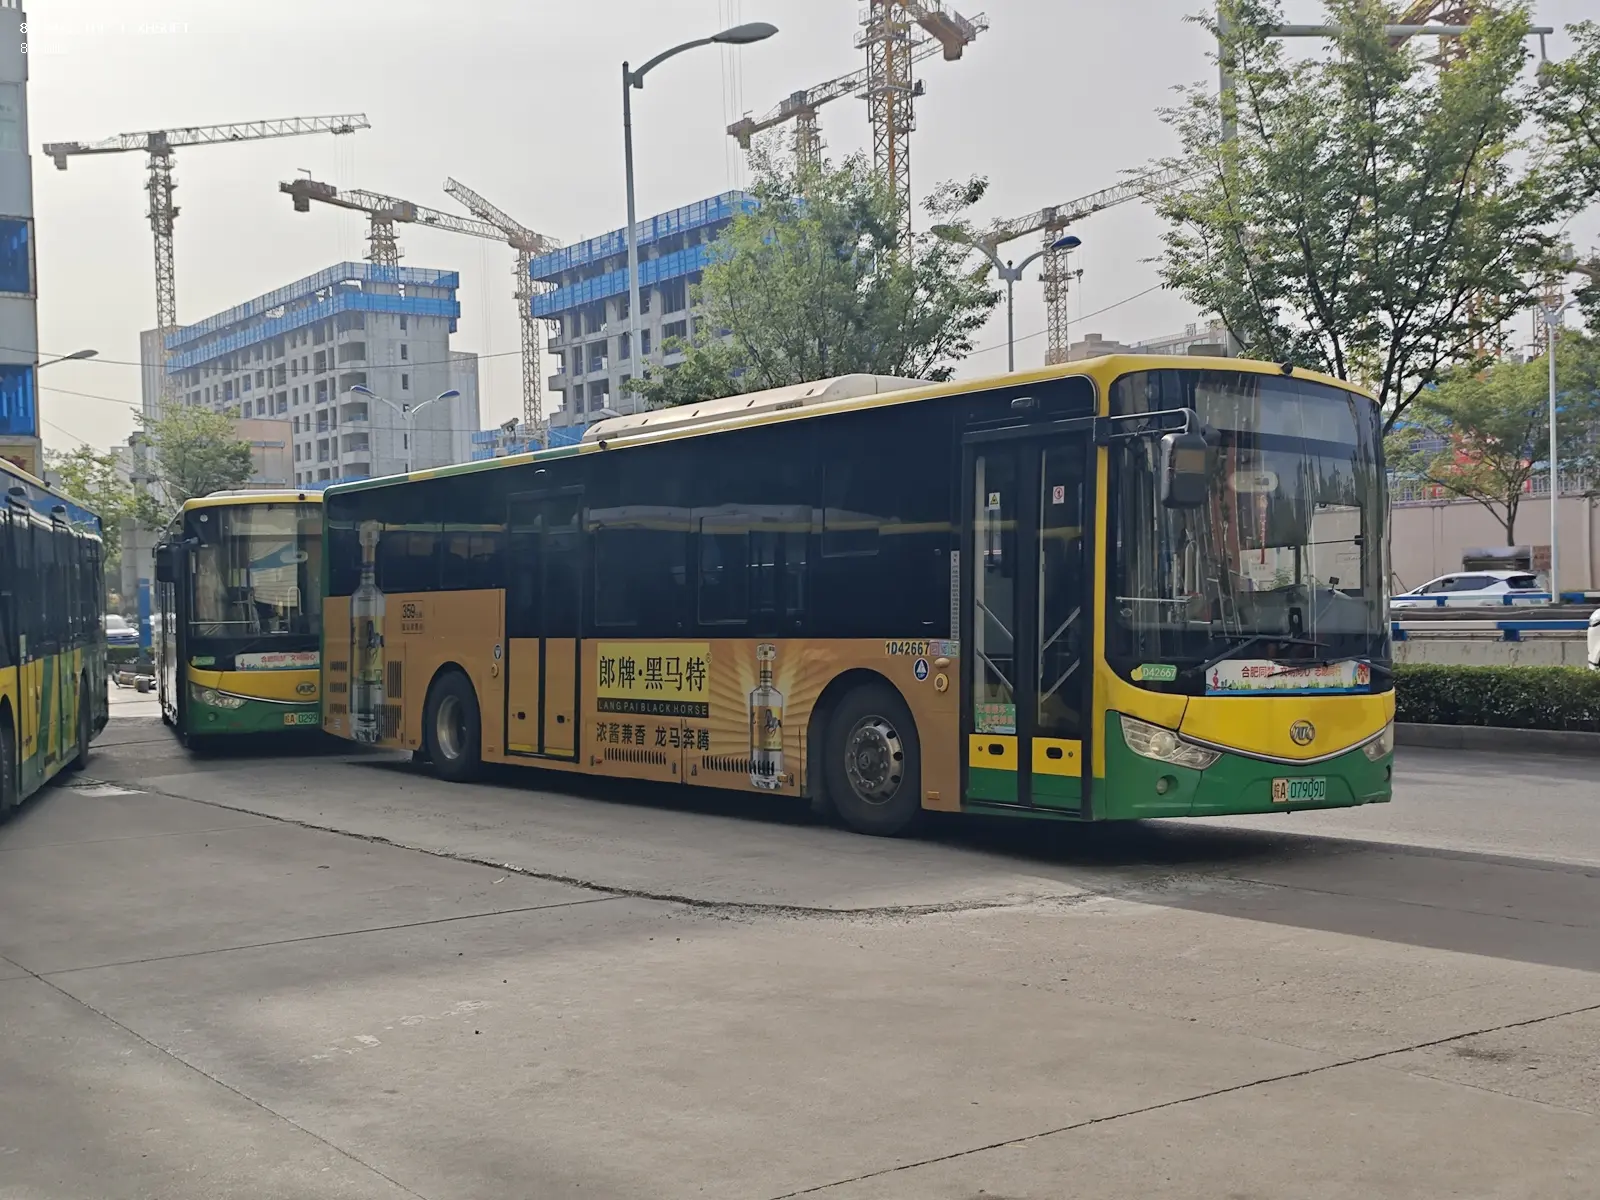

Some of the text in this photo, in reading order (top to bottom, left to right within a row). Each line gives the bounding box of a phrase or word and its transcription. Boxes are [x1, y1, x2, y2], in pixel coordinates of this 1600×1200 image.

[885, 641, 930, 656] 1D42667
[599, 655, 706, 692] 郎牌·黑马特
[1142, 667, 1176, 678] D42667
[598, 700, 708, 716] LANG PAI BLACK HORSE
[596, 722, 710, 751] 浓酱兼香 龙马奔腾
